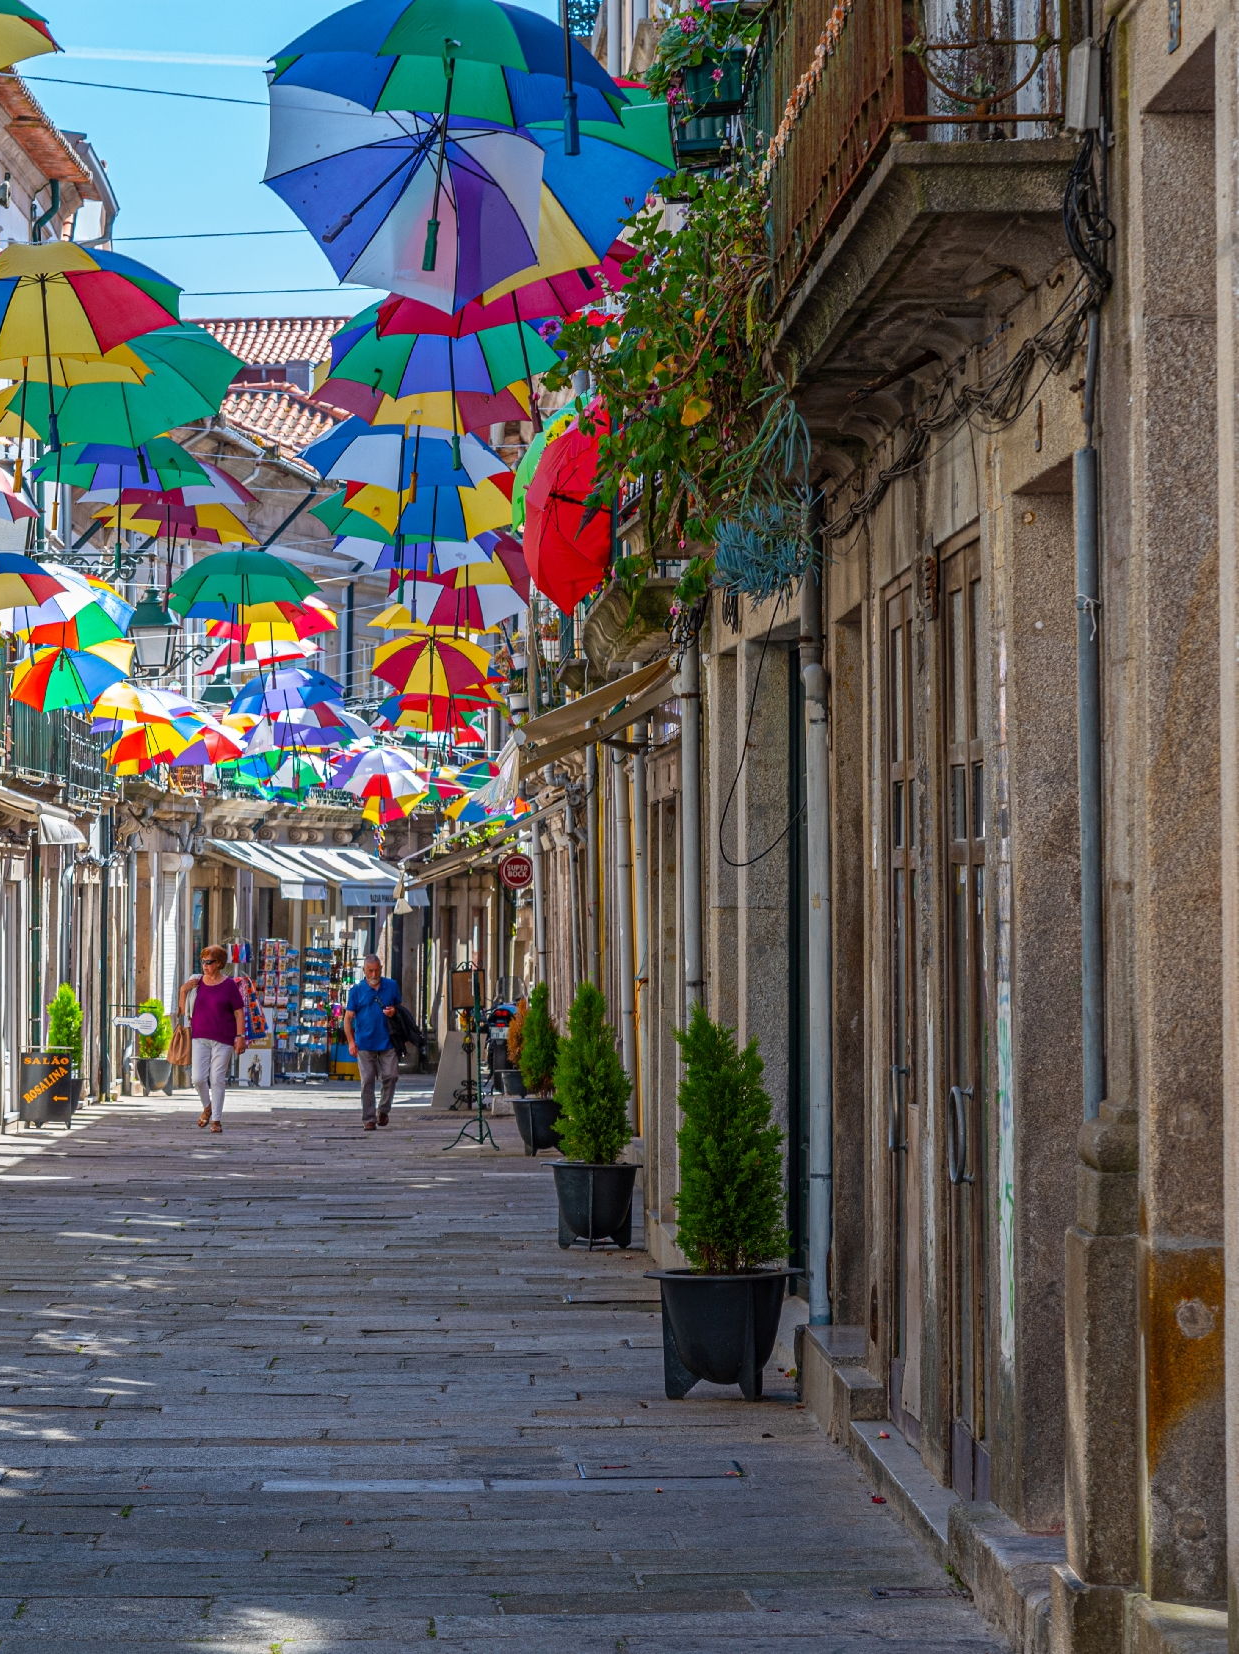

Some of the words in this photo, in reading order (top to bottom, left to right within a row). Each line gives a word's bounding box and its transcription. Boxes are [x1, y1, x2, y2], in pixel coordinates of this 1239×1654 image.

[507, 870, 528, 878] BOCK
[23, 1055, 70, 1065] SALÃO
[22, 1066, 69, 1104] ROSALINA
